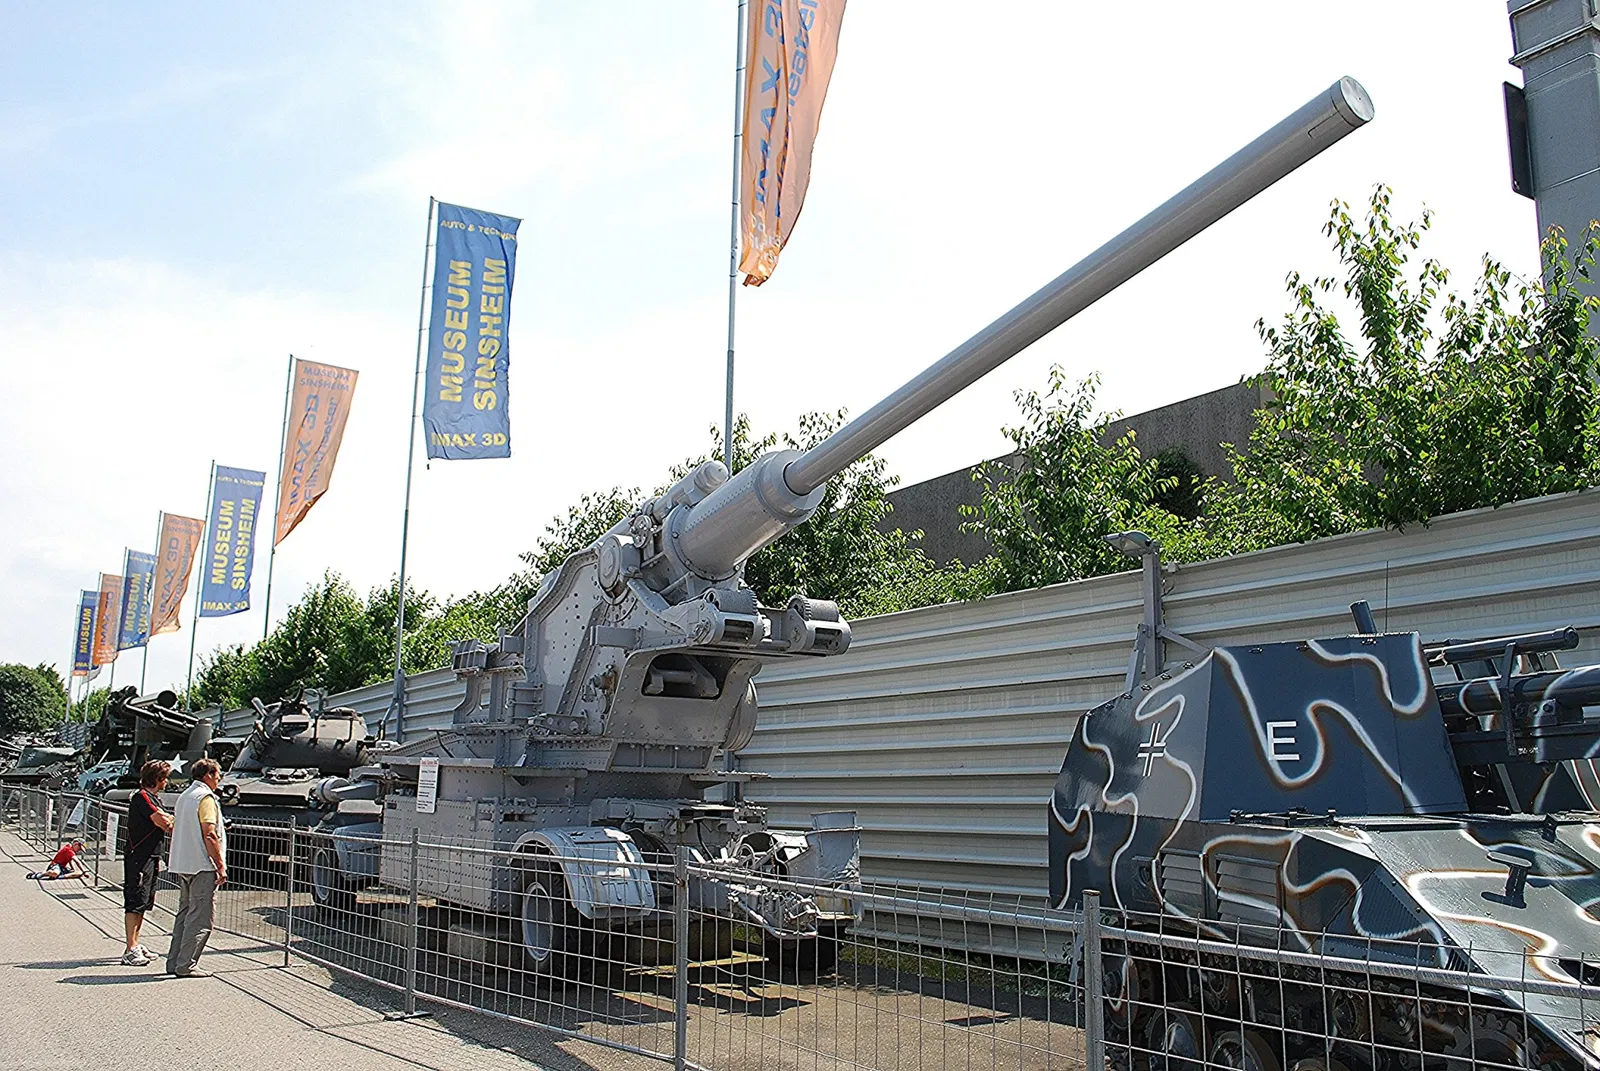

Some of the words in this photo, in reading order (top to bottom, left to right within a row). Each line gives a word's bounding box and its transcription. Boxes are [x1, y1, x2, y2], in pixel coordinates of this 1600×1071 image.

[440, 219, 466, 231] AUTO
[467, 223, 475, 232] &
[440, 259, 472, 403] MUSEUM
[473, 257, 506, 411] SINSHEIM
[300, 377, 350, 392] SINSHEIM
[303, 367, 350, 381] MUSEUM
[289, 439, 313, 506] IMAX
[301, 393, 321, 430] 3D
[431, 432, 477, 447] IMAX
[481, 432, 507, 446] 3D
[167, 537, 180, 562] 3D
[211, 499, 235, 585] MUSEUM
[231, 498, 256, 591] SINSHEIM
[124, 572, 142, 632] MUSEUM
[202, 601, 232, 611] IMAX
[80, 608, 92, 654] MUSEUM
[100, 614, 111, 646] IMAX
[1266, 721, 1300, 760] E
